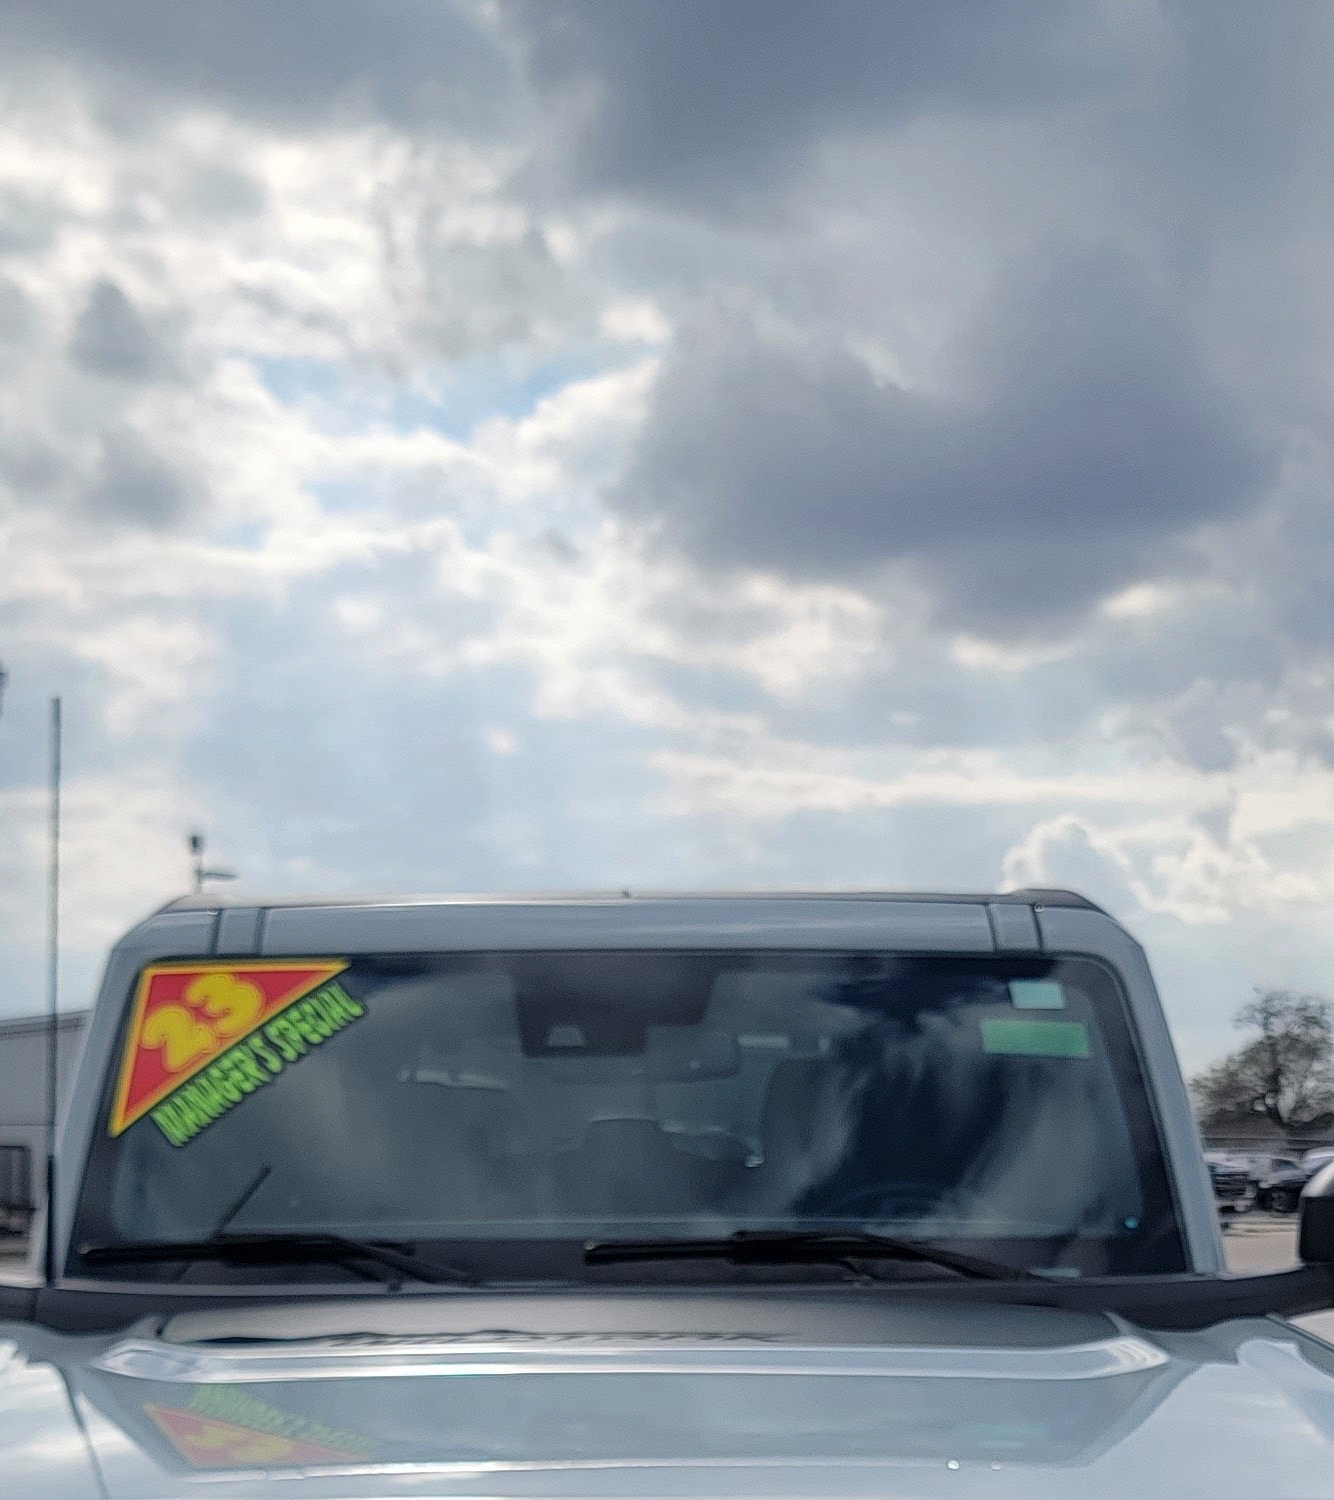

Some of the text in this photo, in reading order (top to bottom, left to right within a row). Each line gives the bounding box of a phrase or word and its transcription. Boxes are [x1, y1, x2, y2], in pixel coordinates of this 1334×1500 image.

[141, 972, 264, 1073] 23
[150, 980, 364, 1147] MANAGER'S SPECIAL
